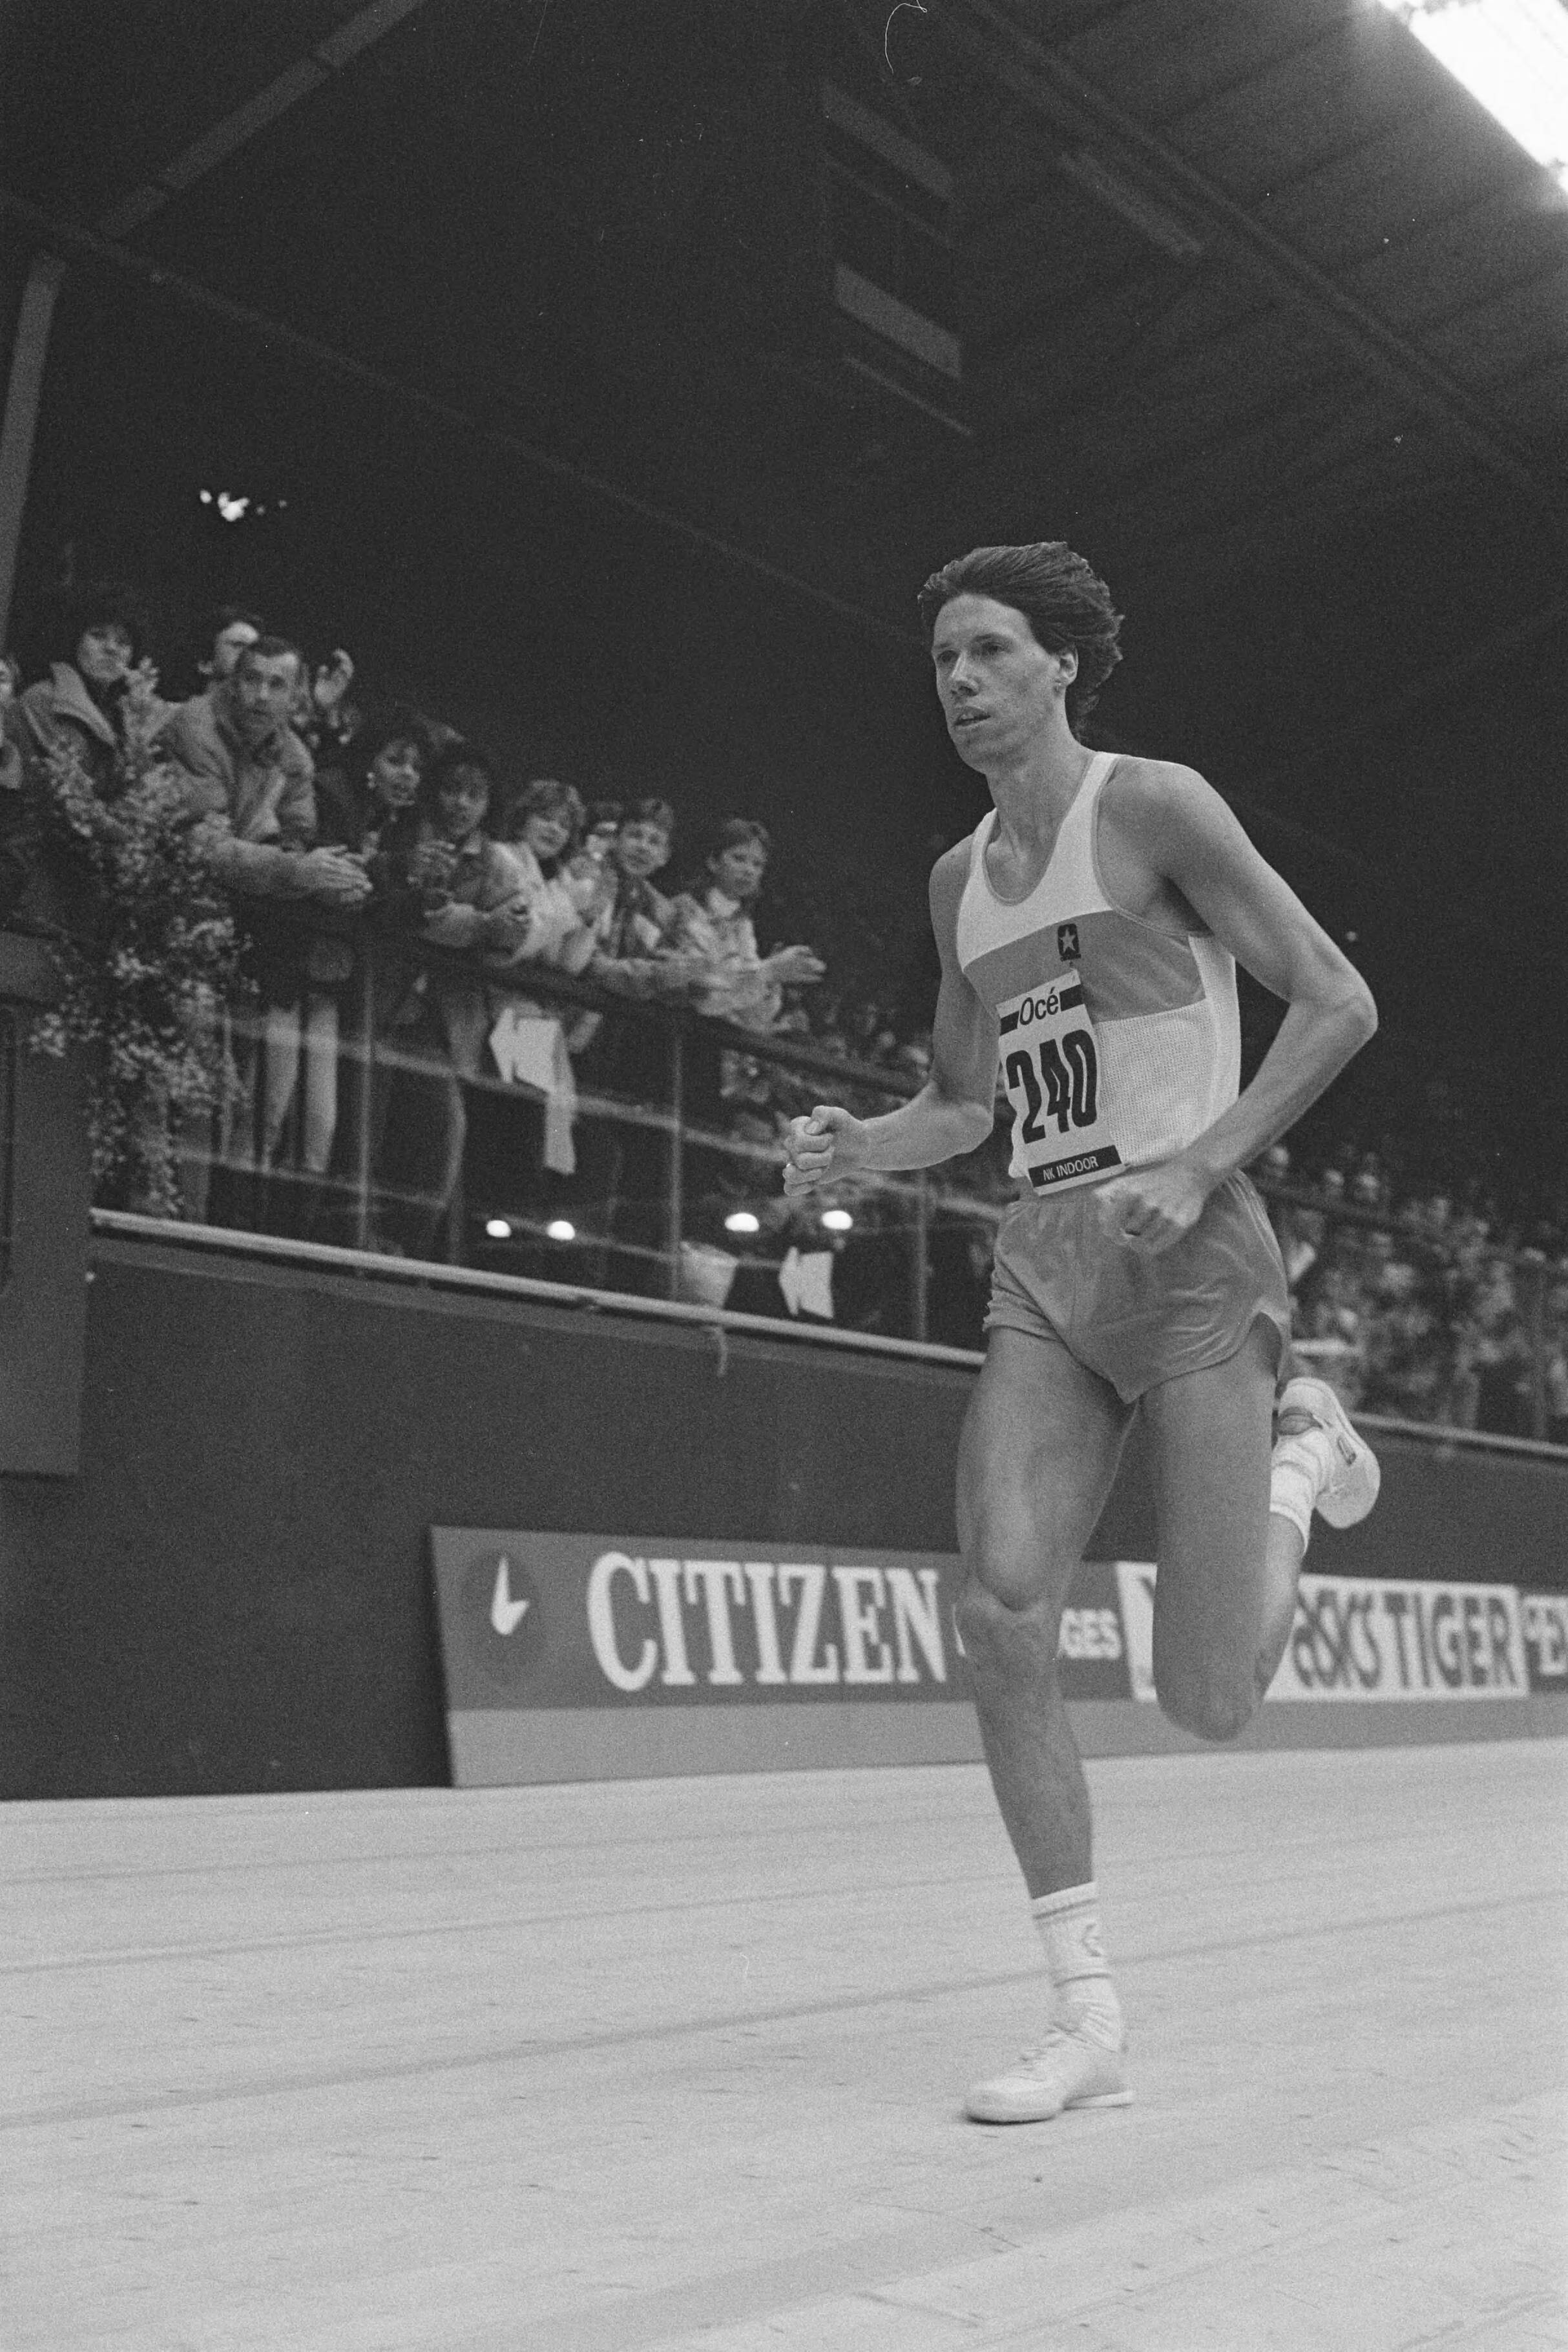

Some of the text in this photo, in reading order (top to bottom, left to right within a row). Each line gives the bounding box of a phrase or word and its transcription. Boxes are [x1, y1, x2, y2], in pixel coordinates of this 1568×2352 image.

[1019, 986, 1060, 1026] Océ
[1005, 1029, 1098, 1144] 240
[1042, 1155, 1099, 1181] NK INDOOR
[586, 1551, 947, 1692] CITIZEN
